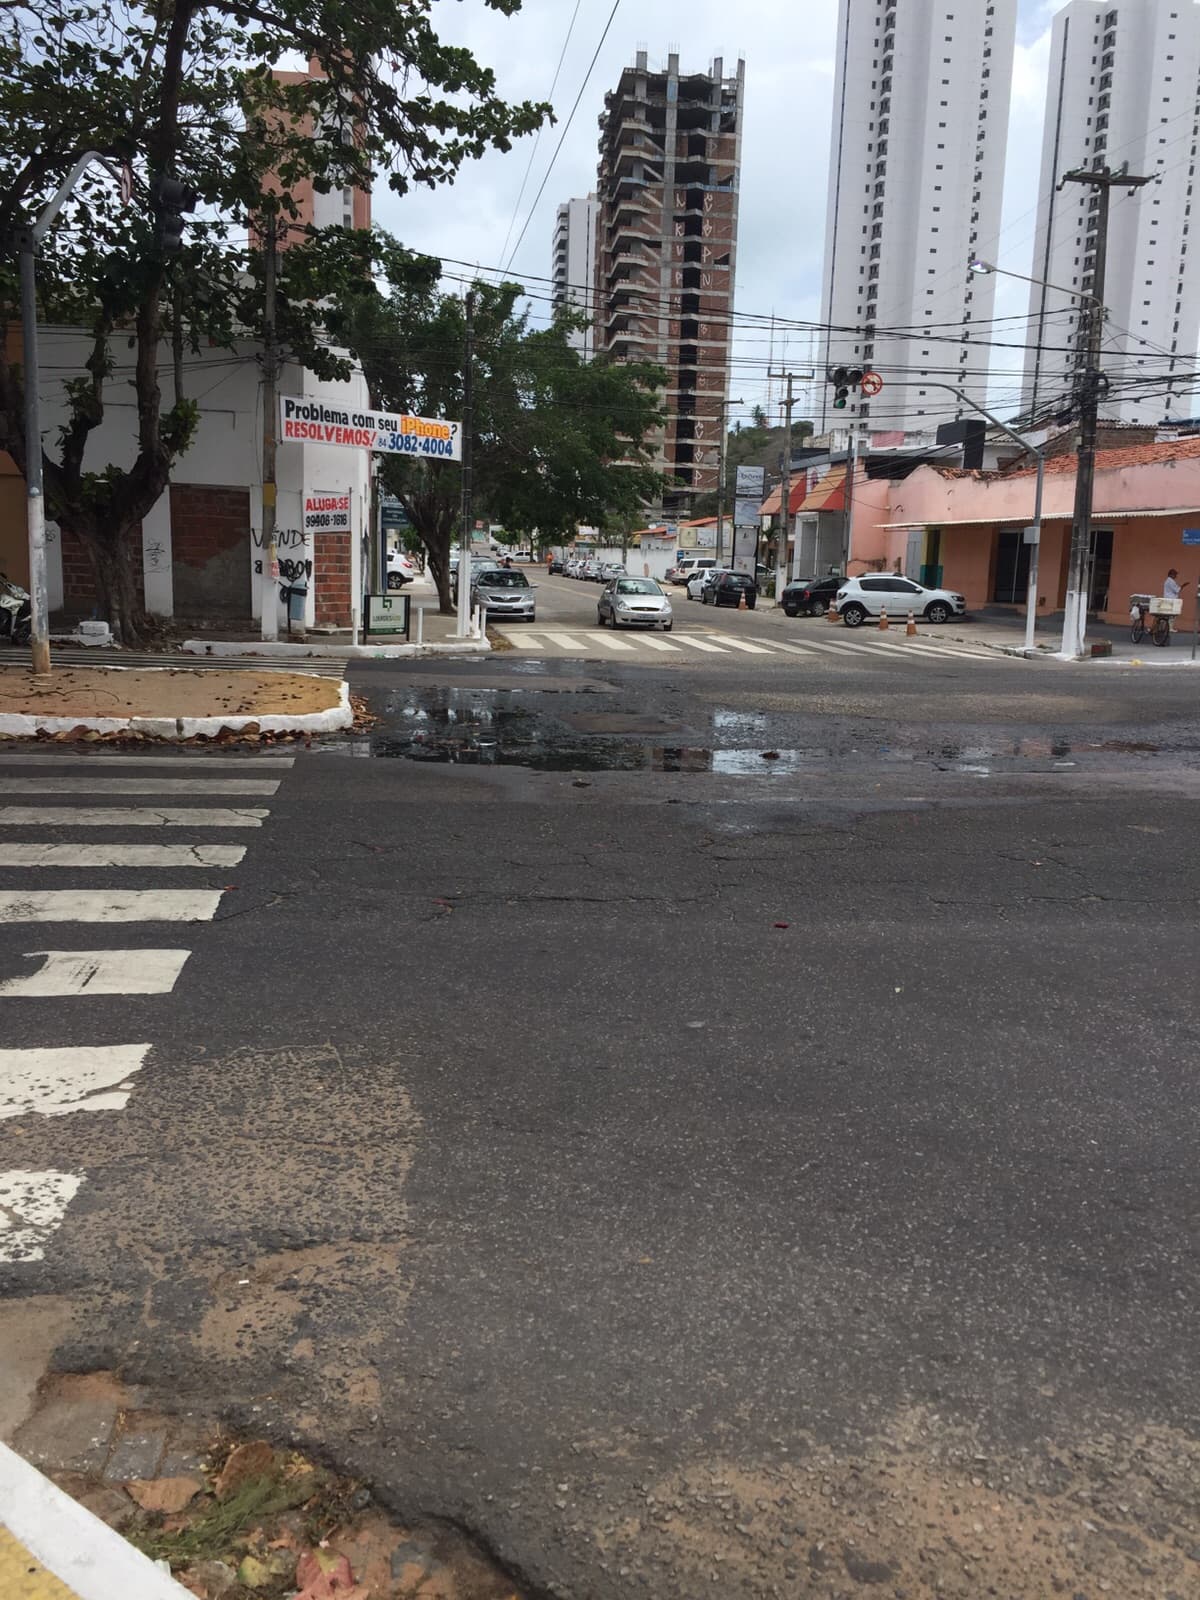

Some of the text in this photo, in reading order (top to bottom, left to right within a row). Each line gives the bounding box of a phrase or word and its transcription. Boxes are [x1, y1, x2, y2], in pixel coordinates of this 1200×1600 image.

[285, 400, 348, 425] Problema
[352, 414, 375, 429] com
[378, 418, 398, 432] seu
[285, 420, 377, 447] RESOLVEMOS!
[305, 497, 349, 511] ALUGA-SE
